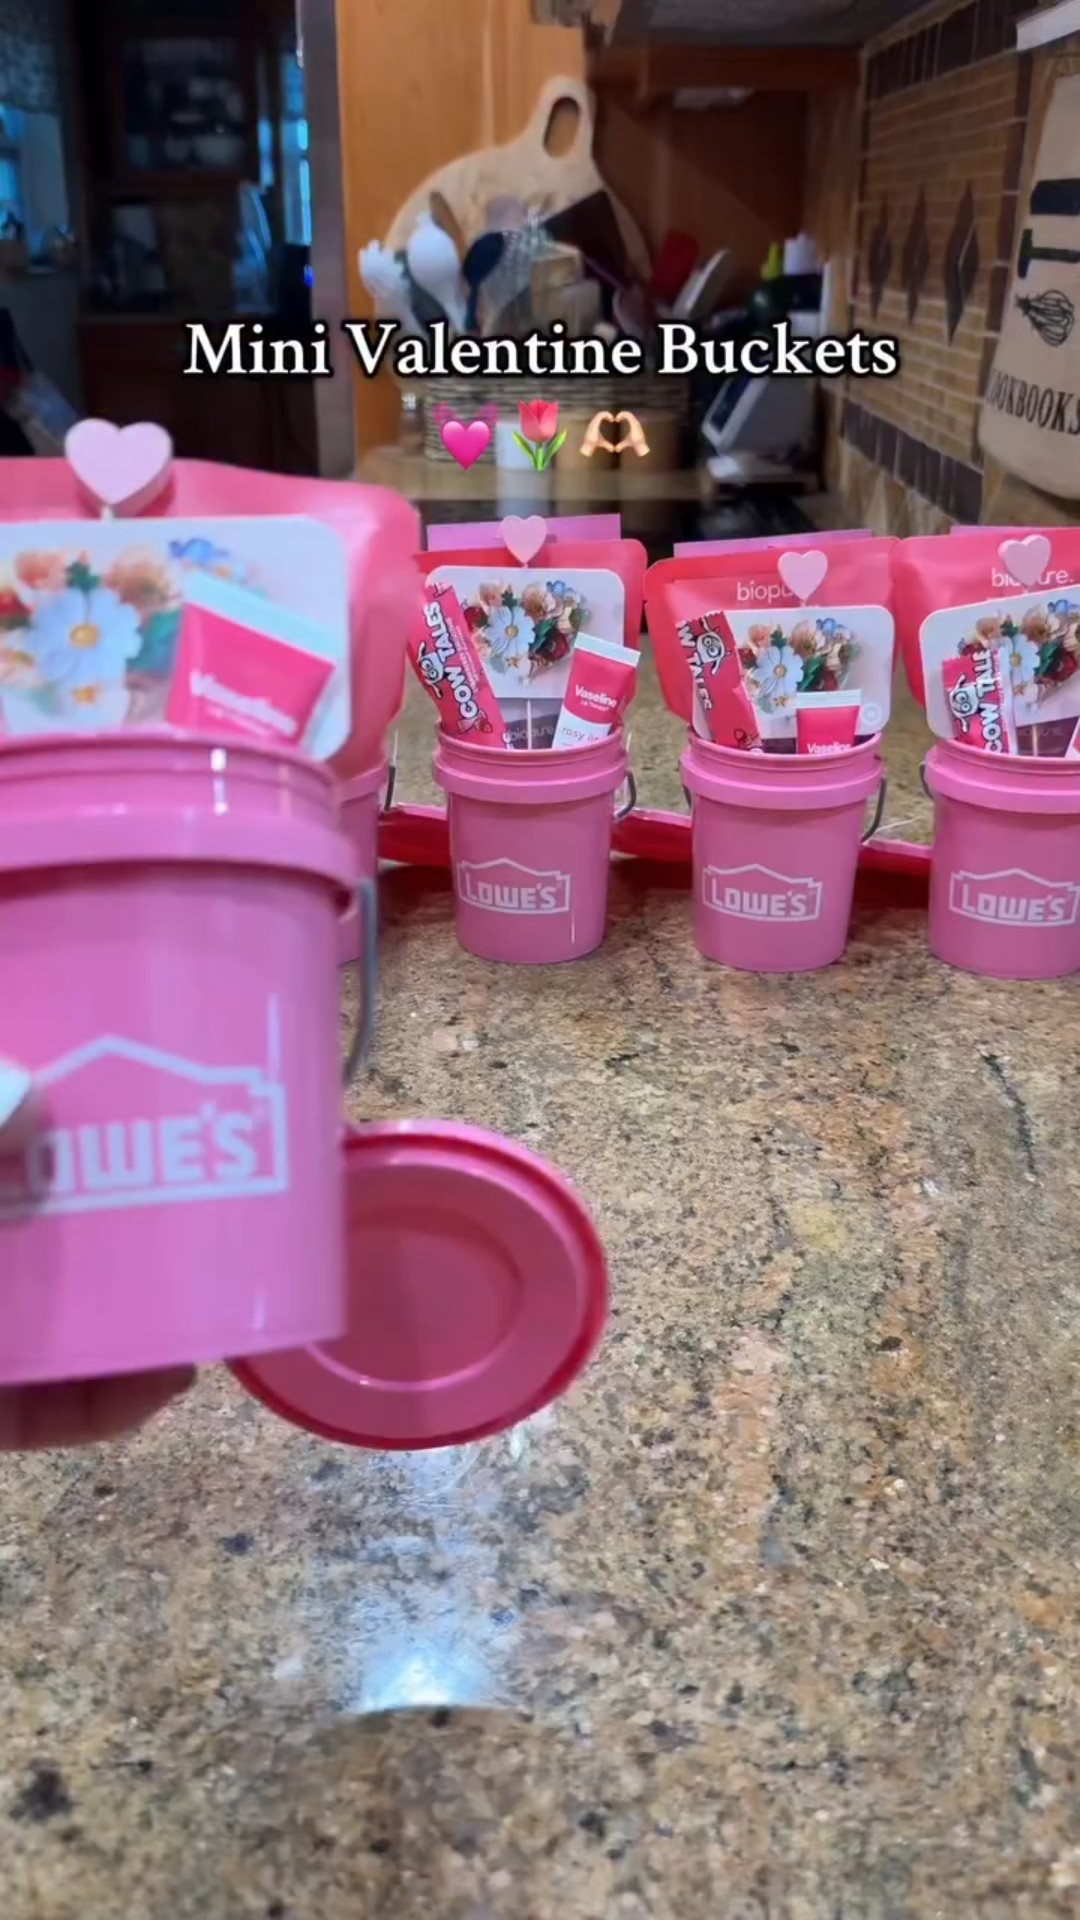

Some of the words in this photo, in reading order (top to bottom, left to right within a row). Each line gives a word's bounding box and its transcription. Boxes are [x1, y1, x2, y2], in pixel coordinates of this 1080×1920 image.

[737, 581, 793, 603] biopu
[423, 600, 456, 663] TALES
[444, 665, 479, 719] COW
[575, 684, 618, 708] Vaseline
[561, 726, 586, 742] rosy
[466, 872, 557, 909] LOWE'S
[712, 878, 808, 916] LOWE'S
[961, 883, 1067, 921] LOWE'S
[24, 1101, 258, 1195] OWE'S
